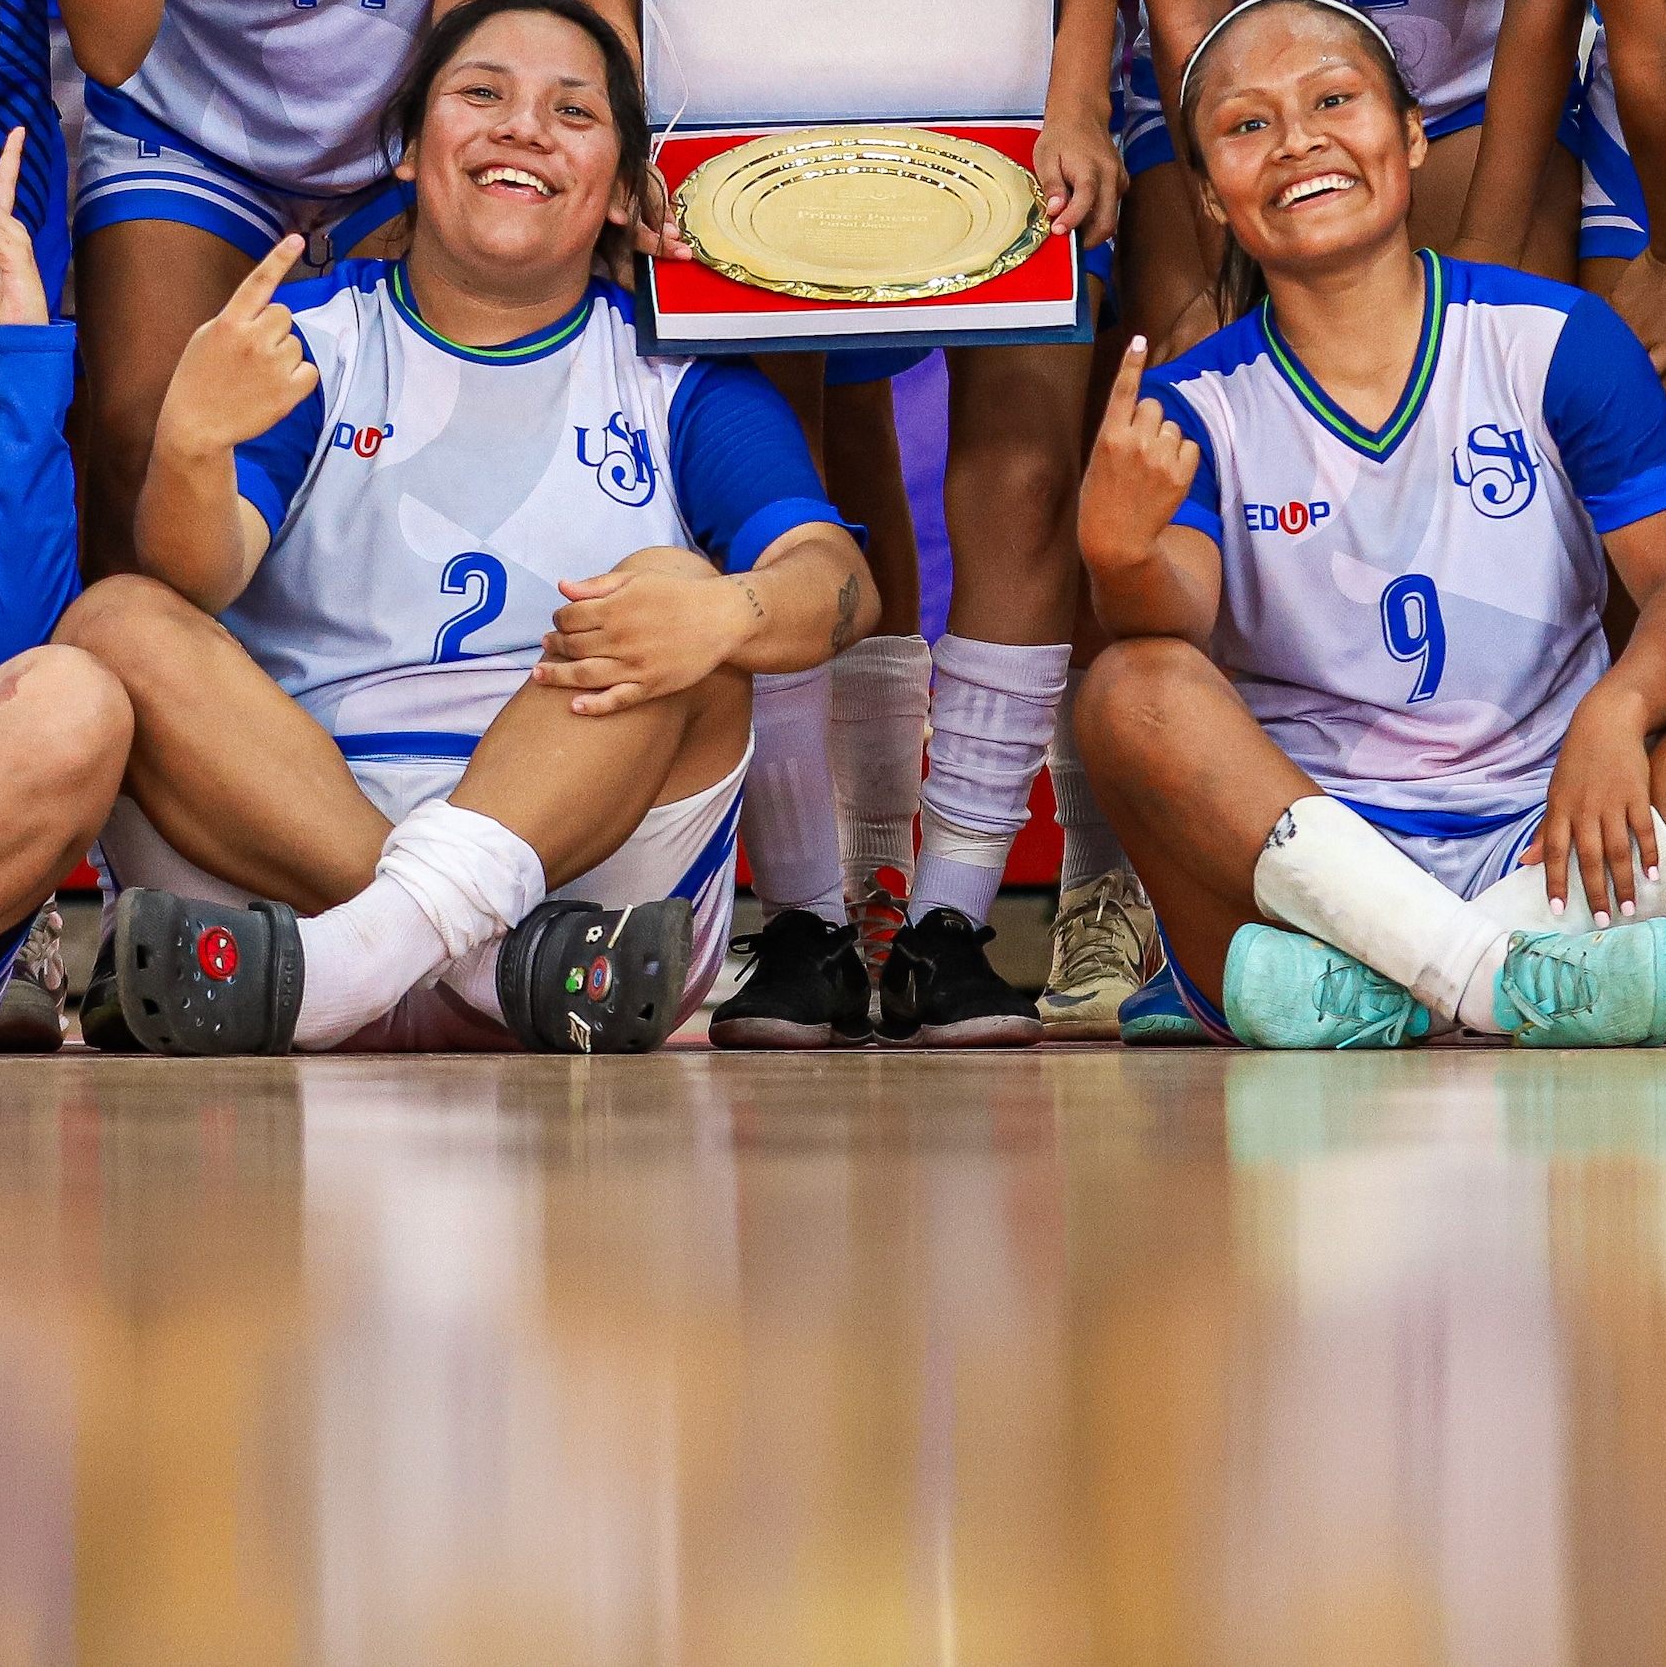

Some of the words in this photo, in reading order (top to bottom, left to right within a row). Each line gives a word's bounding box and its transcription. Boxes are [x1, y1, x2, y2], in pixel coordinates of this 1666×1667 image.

[1243, 501, 1330, 534] EDUP
[433, 551, 508, 664] 2
[1381, 574, 1445, 704] 9
